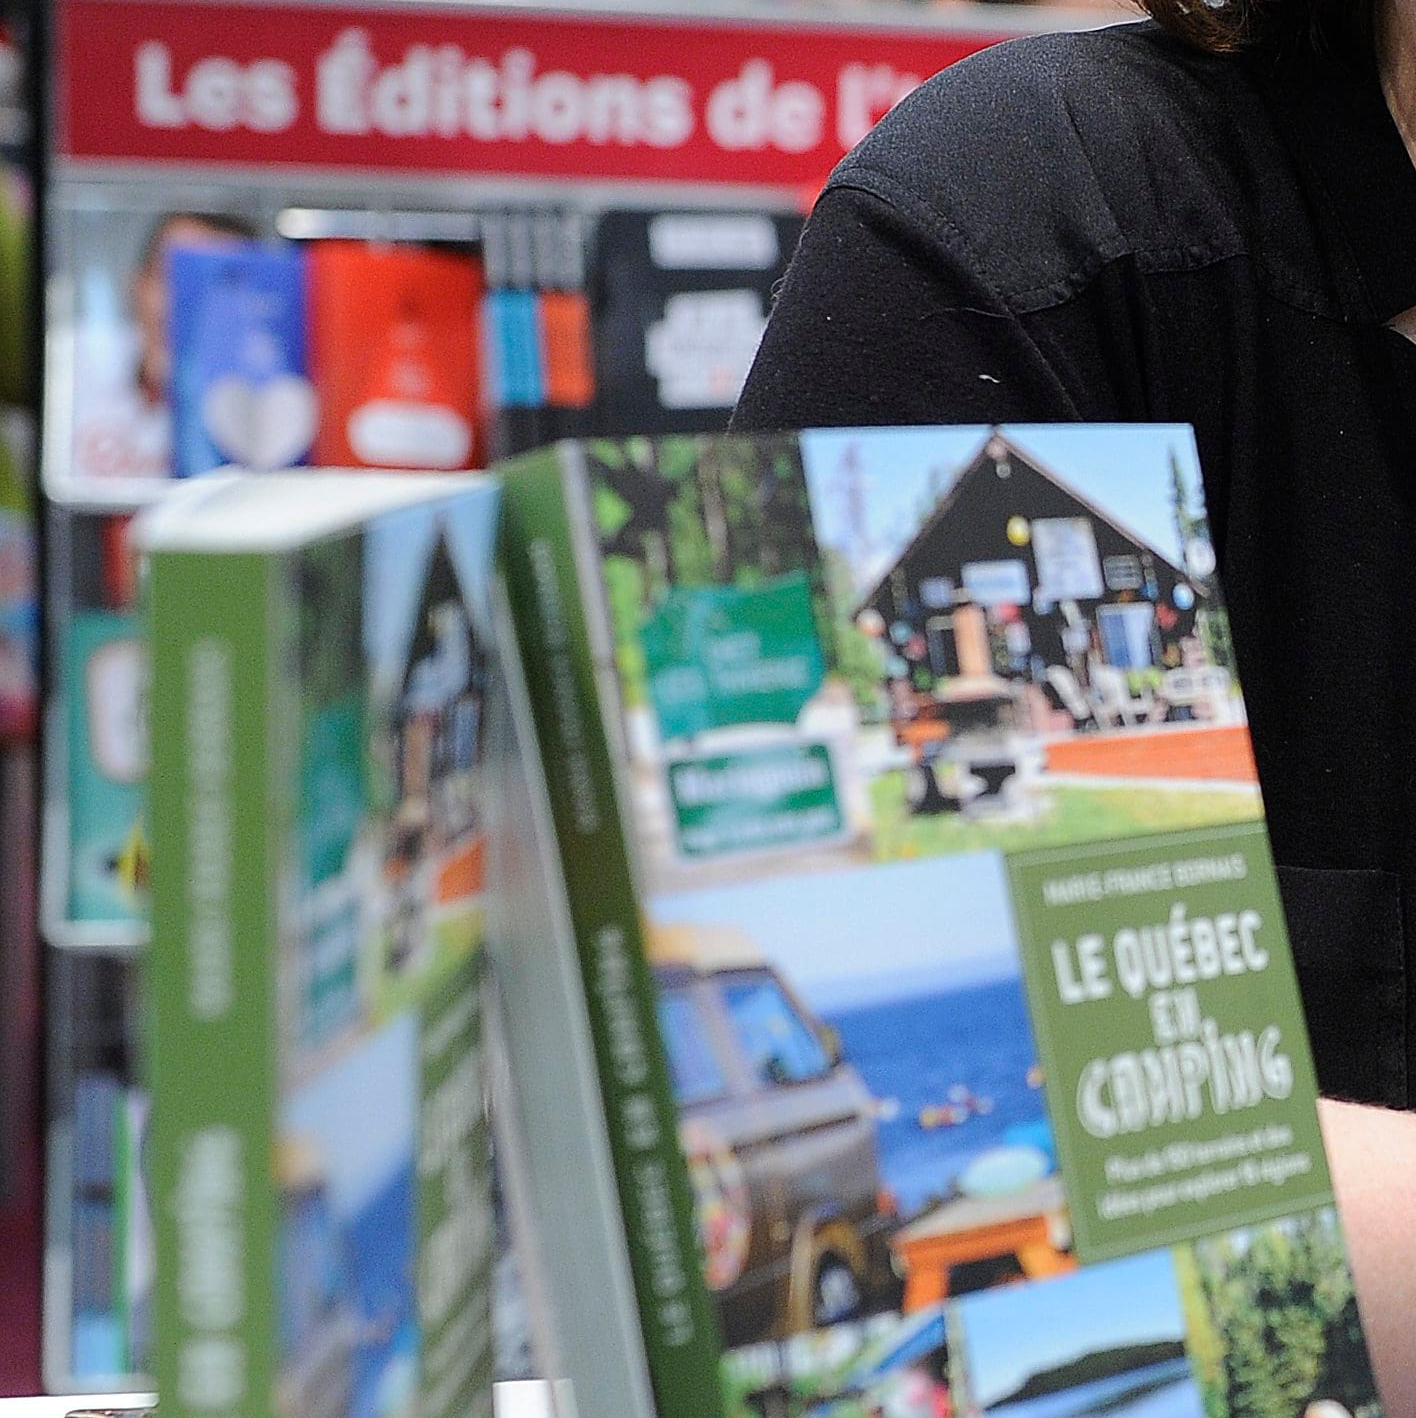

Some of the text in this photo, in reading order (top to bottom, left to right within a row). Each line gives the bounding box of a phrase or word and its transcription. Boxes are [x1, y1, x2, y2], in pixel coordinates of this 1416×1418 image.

[134, 39, 297, 133] Les
[315, 27, 696, 149] Éditions
[704, 56, 825, 153] de
[1052, 900, 1270, 1005] LE QUÉBEC
[1149, 986, 1202, 1047] EN
